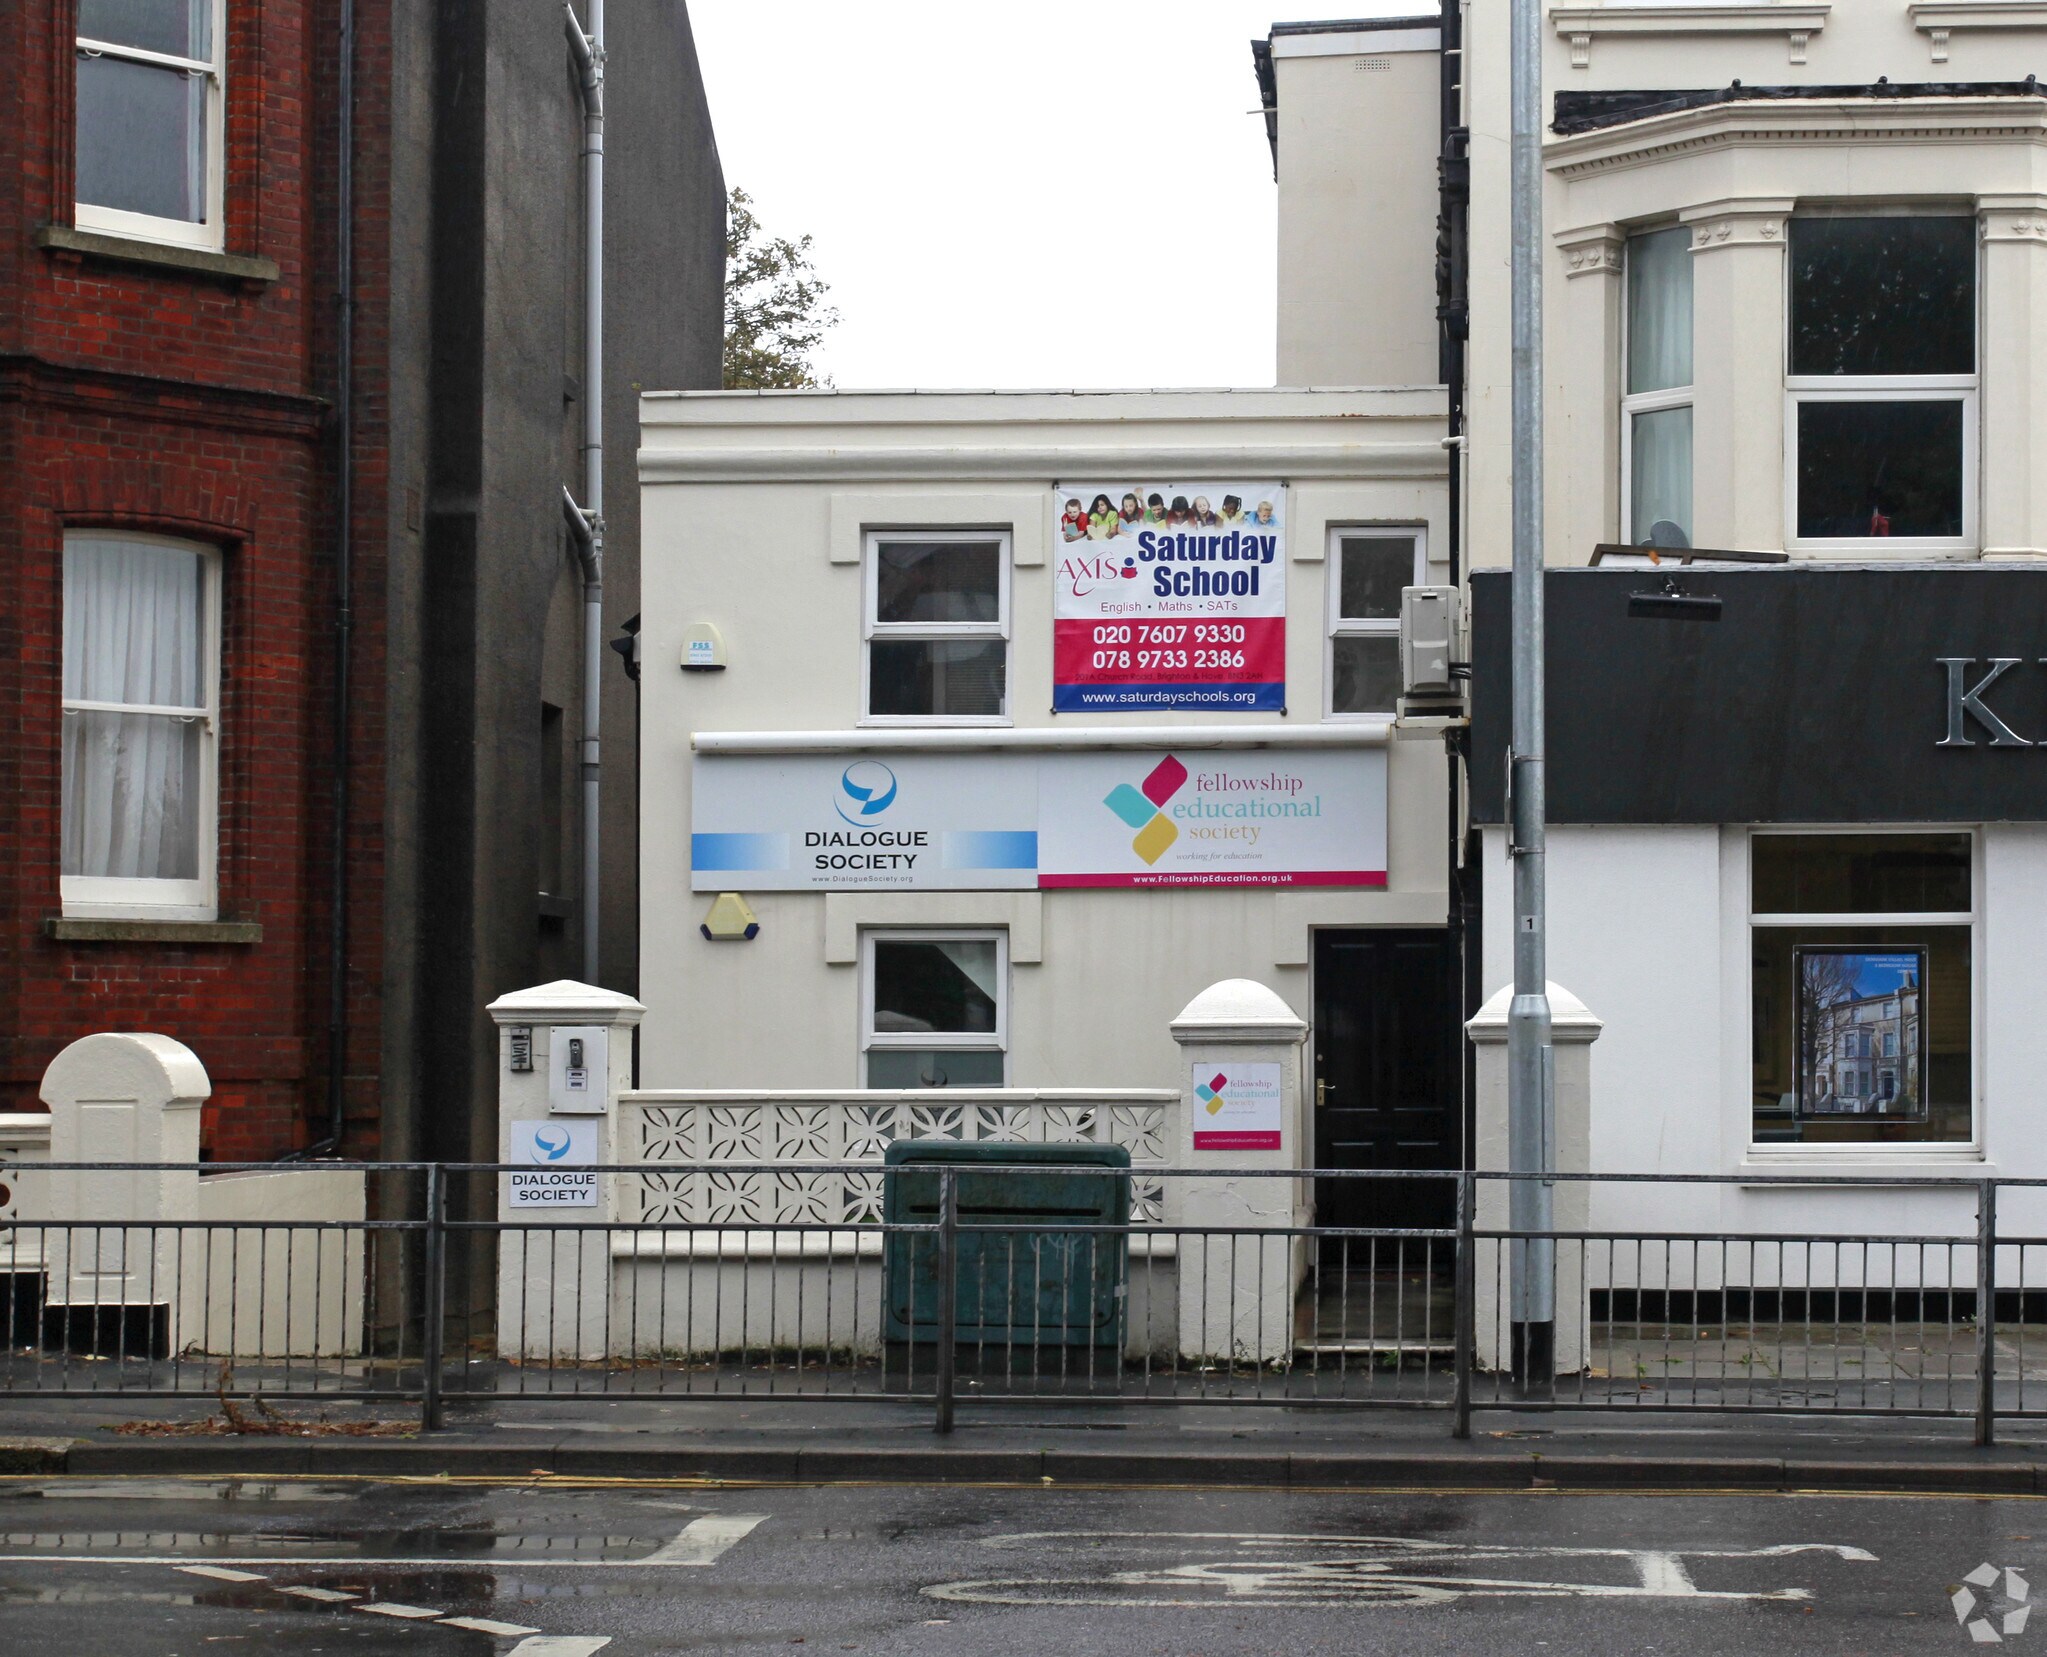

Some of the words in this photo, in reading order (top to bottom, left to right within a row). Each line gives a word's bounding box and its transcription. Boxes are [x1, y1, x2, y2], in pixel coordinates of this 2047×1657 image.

[1138, 531, 1276, 563] Saturday
[1057, 551, 1118, 597] AXIS
[1153, 566, 1259, 597] School
[1100, 602, 1142, 615] English
[1158, 601, 1193, 612] Maths
[1206, 600, 1238, 611] SATs
[1093, 625, 1131, 645] 020
[1138, 625, 1188, 644] 7607
[1194, 624, 1245, 643] 9330
[1092, 650, 1131, 669] 078
[1137, 650, 1188, 668] 9733
[1193, 649, 1245, 668] 2386
[1082, 690, 1256, 704] www.saturdayschools.org
[1196, 773, 1304, 796] fellowship
[1172, 796, 1322, 819] educational
[805, 831, 928, 847] DIALOGUE
[1189, 824, 1262, 845] society
[815, 854, 918, 869] SOCIETY
[1176, 852, 1207, 861] working
[1209, 852, 1222, 861] for
[1223, 852, 1263, 860] education
[811, 875, 913, 884] www.DialogueSociety.org
[1133, 874, 1293, 884] www.FellowshipEducation.org.uk
[1526, 918, 1533, 930] 1
[1230, 1079, 1272, 1089] fellowship
[1221, 1088, 1279, 1098] educational
[512, 1174, 596, 1186] DIALOGUE
[519, 1189, 589, 1201] SOCIETY
